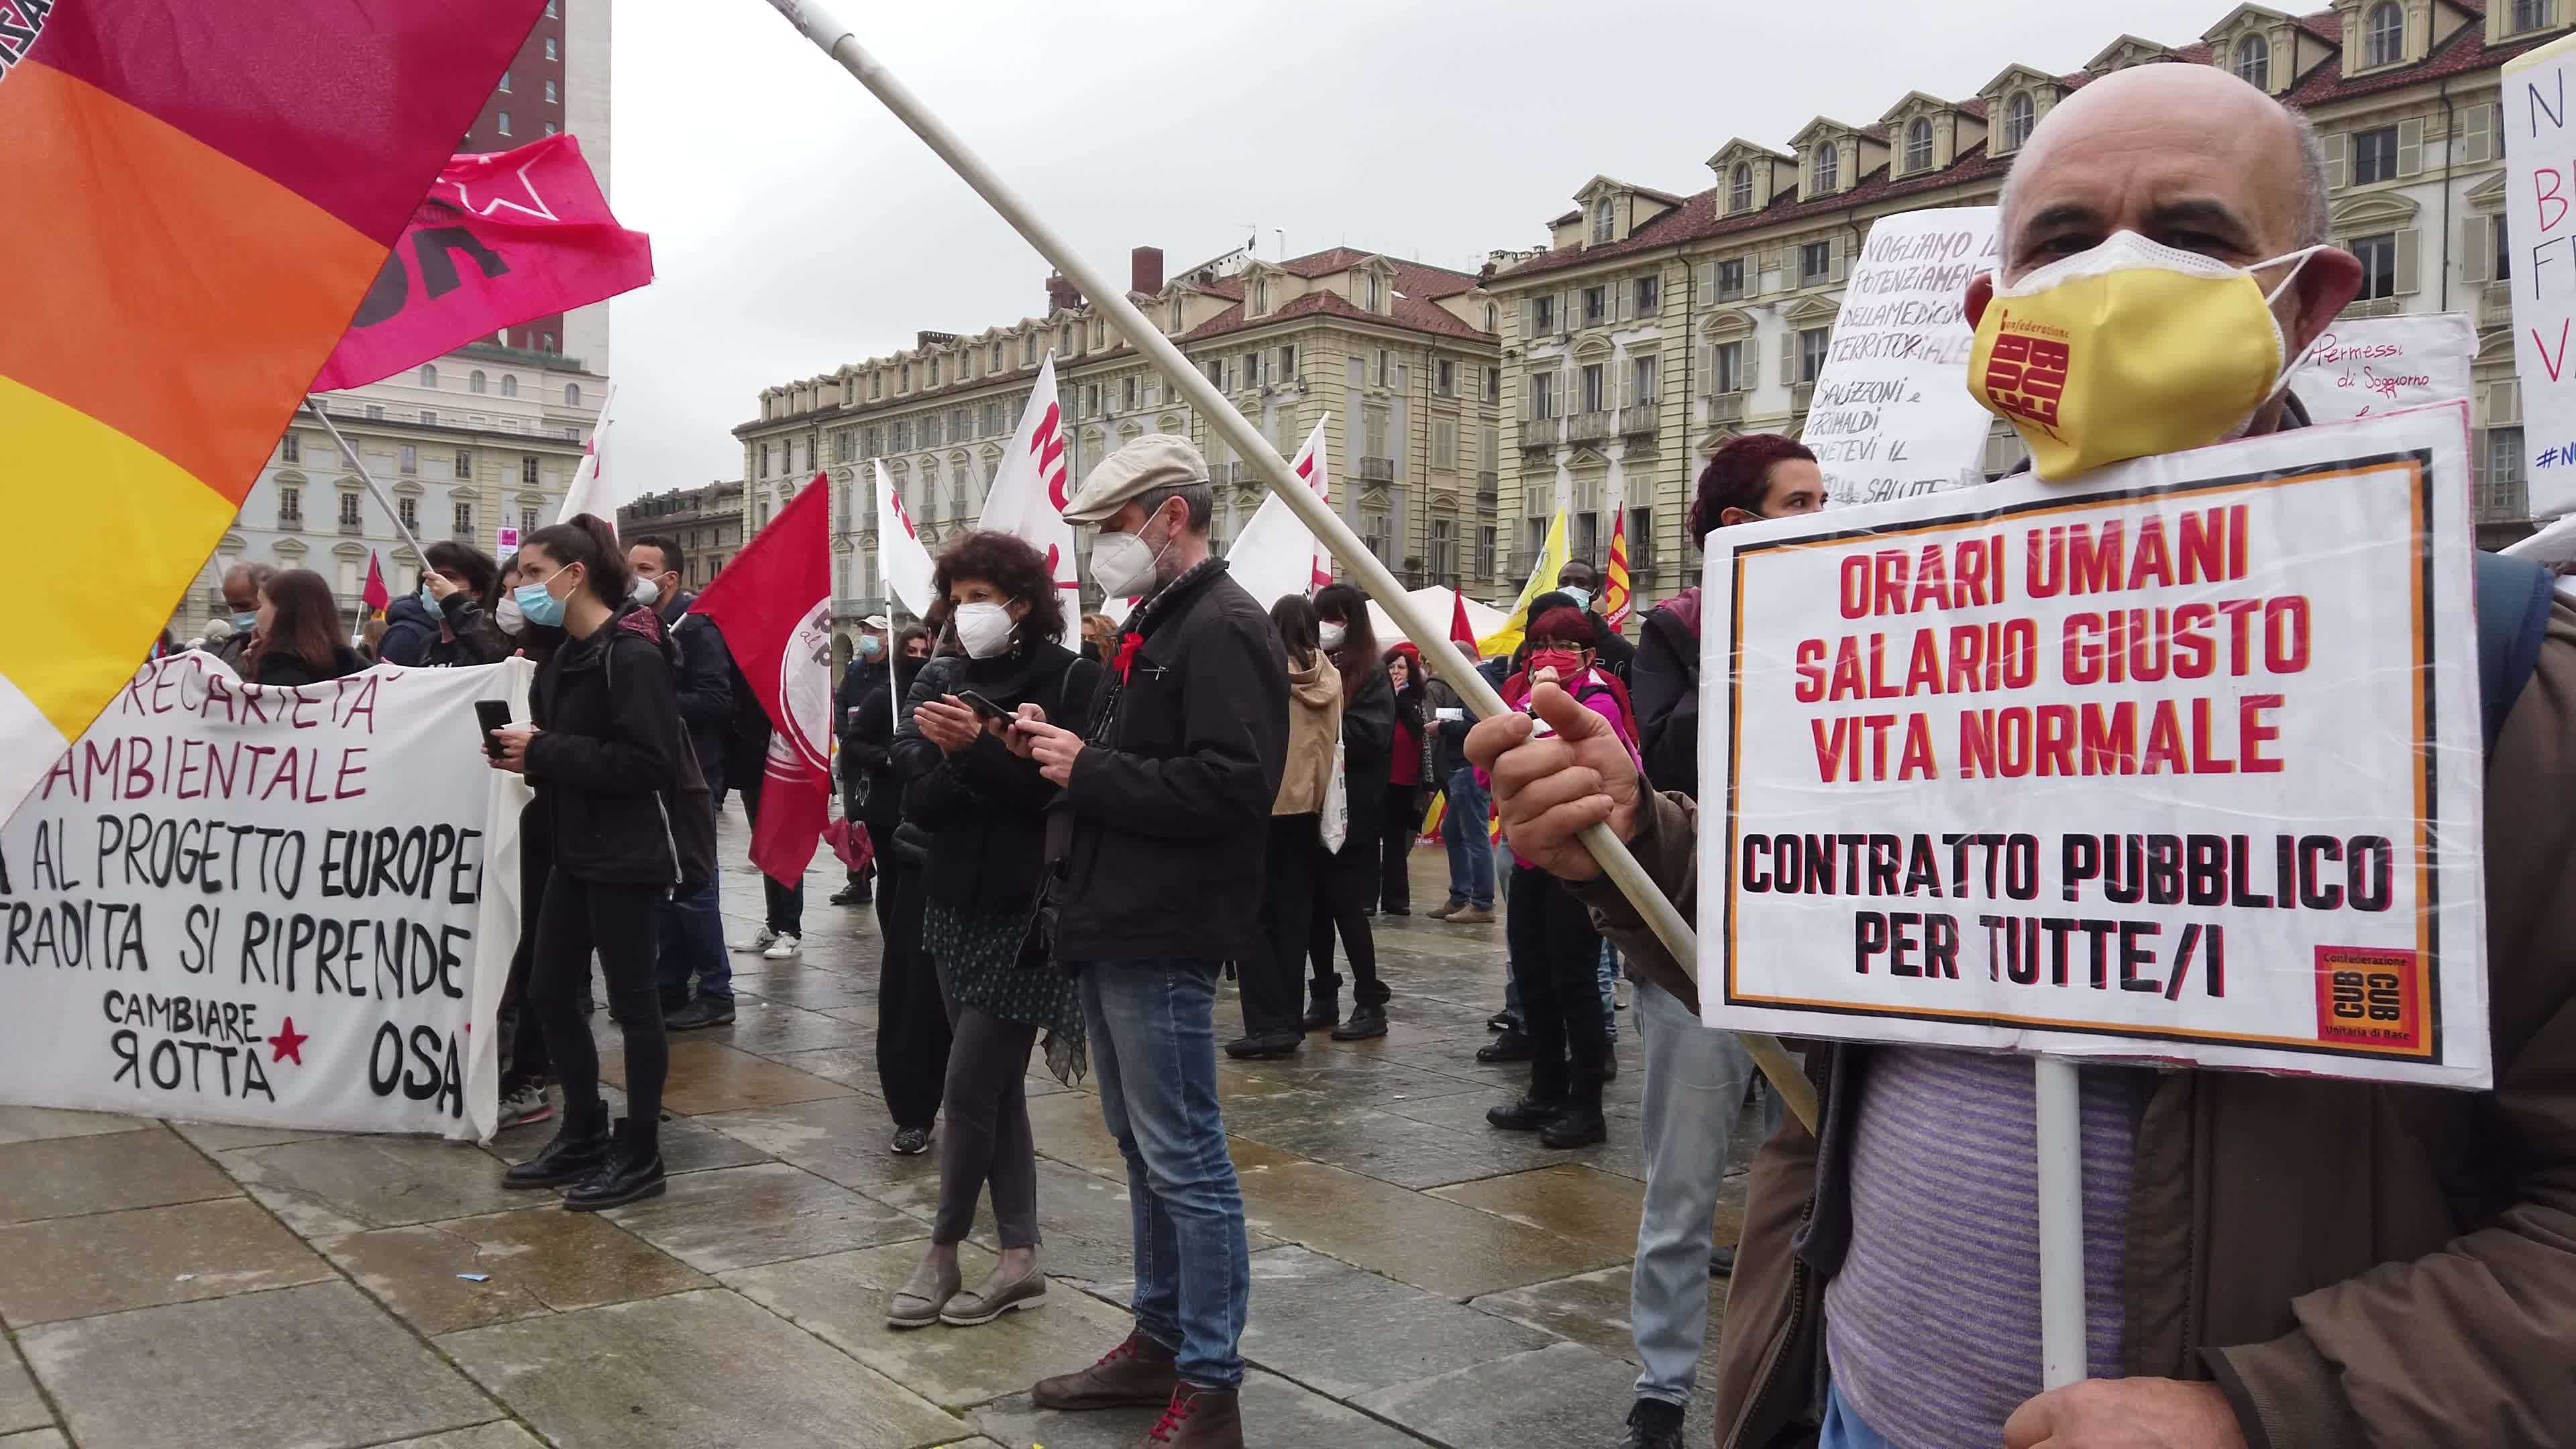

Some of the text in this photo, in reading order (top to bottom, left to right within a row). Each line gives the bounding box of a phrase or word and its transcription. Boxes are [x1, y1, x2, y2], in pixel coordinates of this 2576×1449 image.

[2314, 333, 2403, 366] Permessi
[2337, 367, 2357, 388] di
[1888, 440, 1908, 462] IL
[1841, 504, 2248, 619] ORARI UMANI
[1796, 596, 2310, 703] SALARIO GIUSTO
[42, 735, 368, 804] AMBIENTALE
[1813, 696, 2285, 784] VITA NORMALE
[34, 817, 80, 892] AL
[97, 812, 306, 901] PROGETTO
[319, 823, 484, 905] EUROPE
[1742, 833, 2394, 912] CONTRATTO PUBBLICO
[180, 904, 220, 974] SI
[241, 911, 472, 1001] RIPRENDE
[1856, 911, 2225, 1001] PER TUTTE/I
[2323, 953, 2408, 967] Confederazione
[103, 989, 262, 1045] CAMBIARE
[2332, 971, 2365, 1018] CUB
[2326, 1024, 2410, 1040] Unitaria di Base
[368, 1019, 464, 1120] OSA
